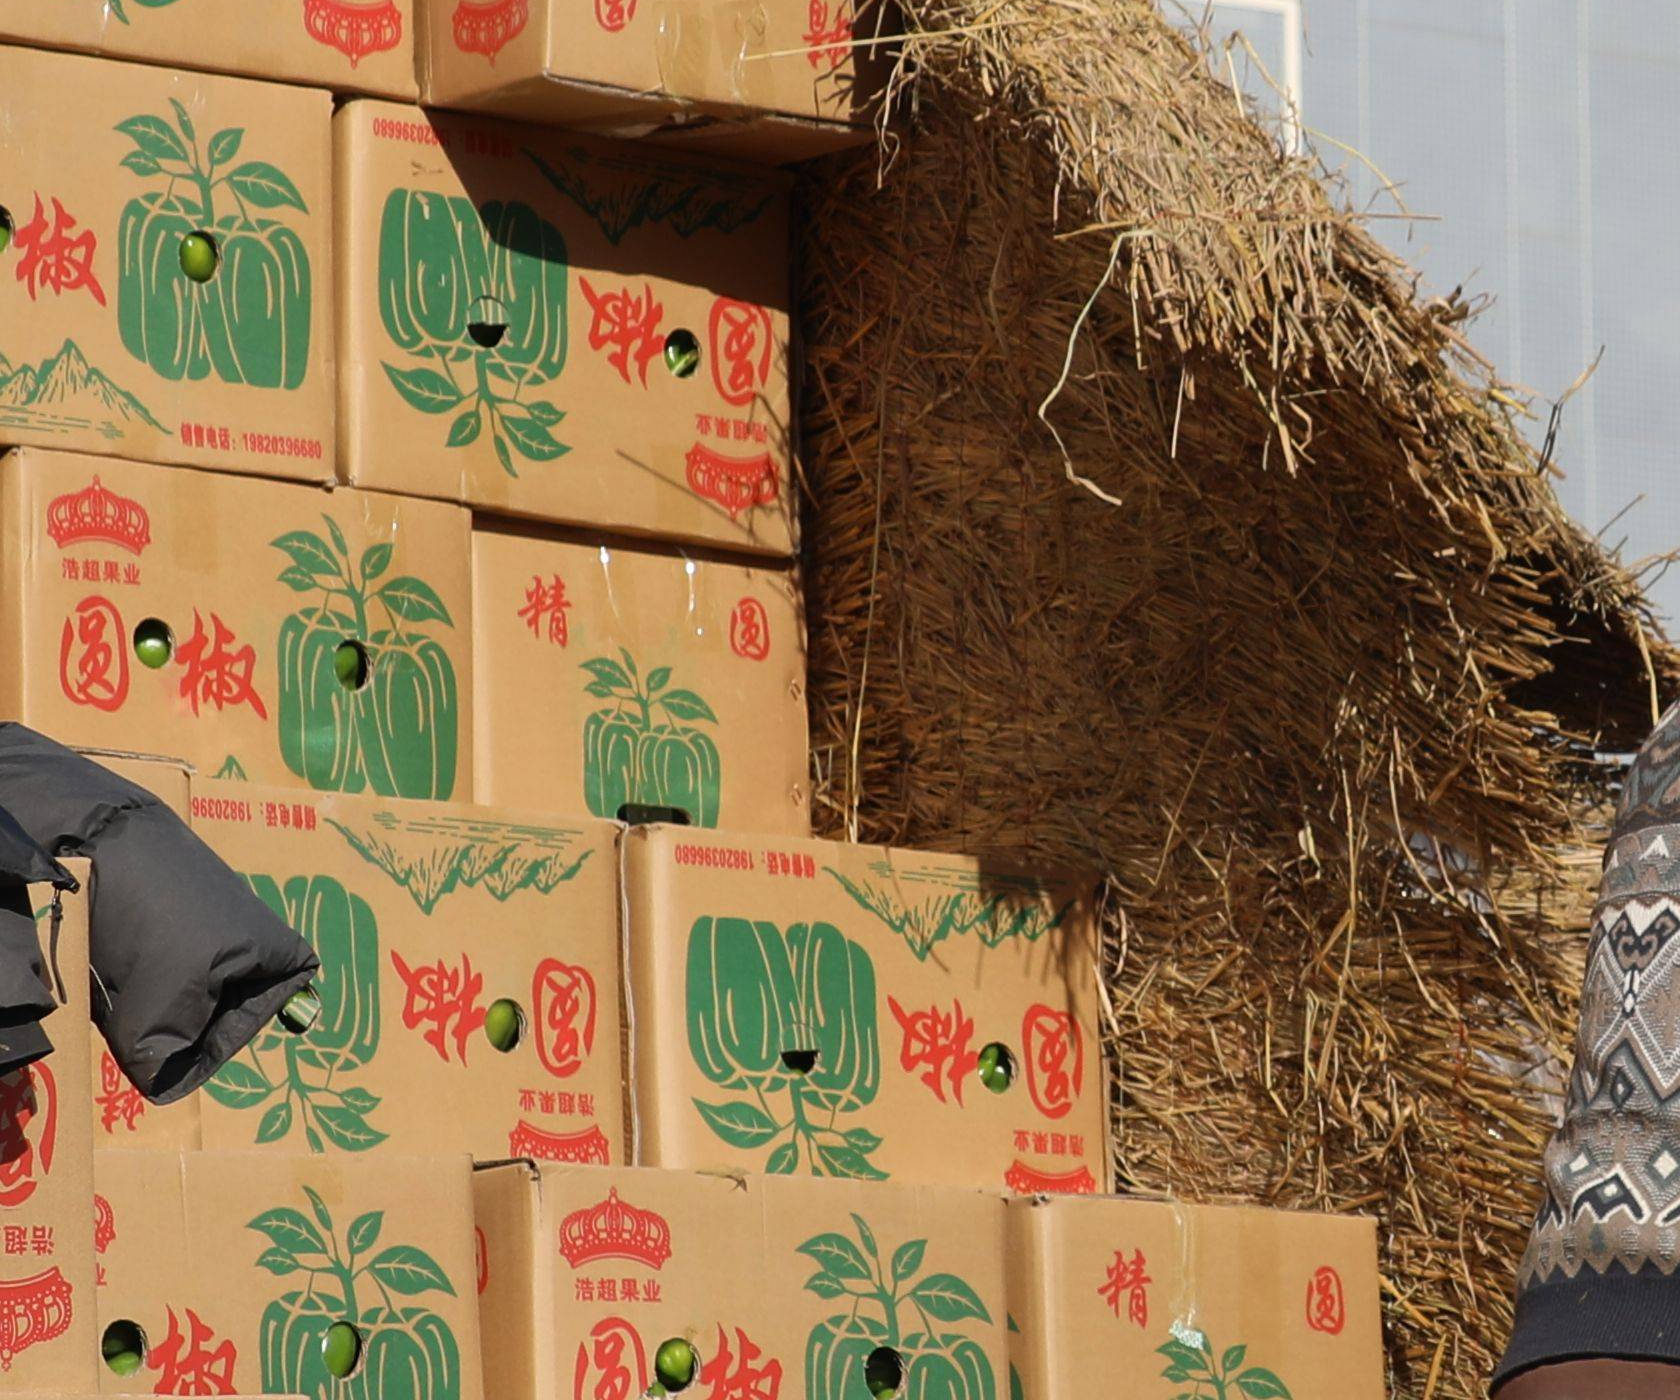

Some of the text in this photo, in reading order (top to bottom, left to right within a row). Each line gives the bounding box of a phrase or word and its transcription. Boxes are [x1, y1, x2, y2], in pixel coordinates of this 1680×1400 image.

[579, 276, 774, 407] 圆椒
[63, 559, 139, 585] 浩超果业
[518, 575, 572, 646] 精
[730, 597, 771, 662] 圆
[60, 595, 267, 720] 圆椒
[391, 951, 596, 1078] 圆椒
[886, 994, 1085, 1121] 圆椒
[520, 1089, 593, 1115] 浩超果业
[1014, 1130, 1084, 1157] 浩超果业
[576, 1279, 660, 1302] 浩超果业
[1098, 1249, 1152, 1328] 精
[1306, 1265, 1346, 1336] 圆
